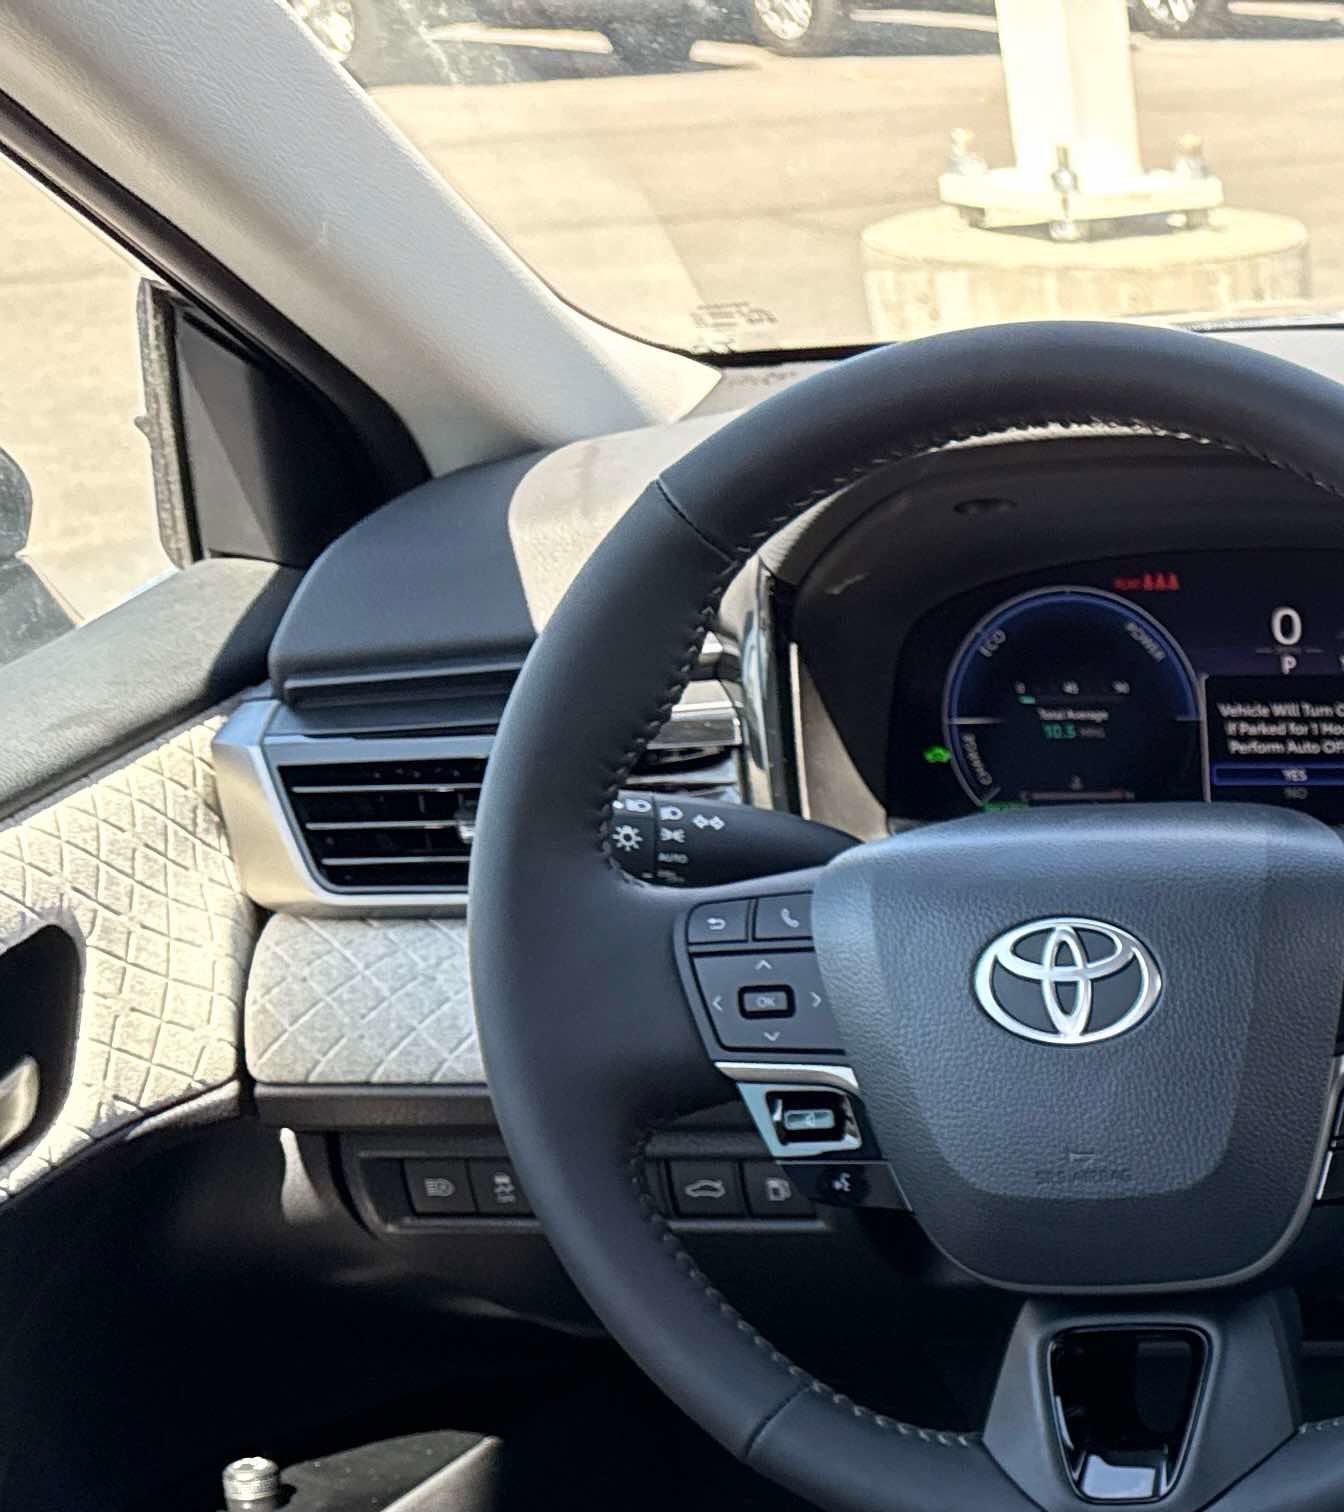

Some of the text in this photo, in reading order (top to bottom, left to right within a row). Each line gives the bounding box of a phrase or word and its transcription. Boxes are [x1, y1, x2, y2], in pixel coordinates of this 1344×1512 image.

[1271, 606, 1302, 645] 0
[1281, 655, 1297, 674] P
[1217, 703, 1270, 717] Vehicle
[1271, 702, 1301, 717] Will
[1302, 702, 1333, 717] Turn
[1239, 721, 1287, 736] Parked
[1228, 739, 1285, 755] Perform
[1286, 739, 1321, 754] Auto
[1282, 768, 1308, 782] YES
[658, 852, 689, 864] AUTO
[756, 996, 776, 1008] OK
